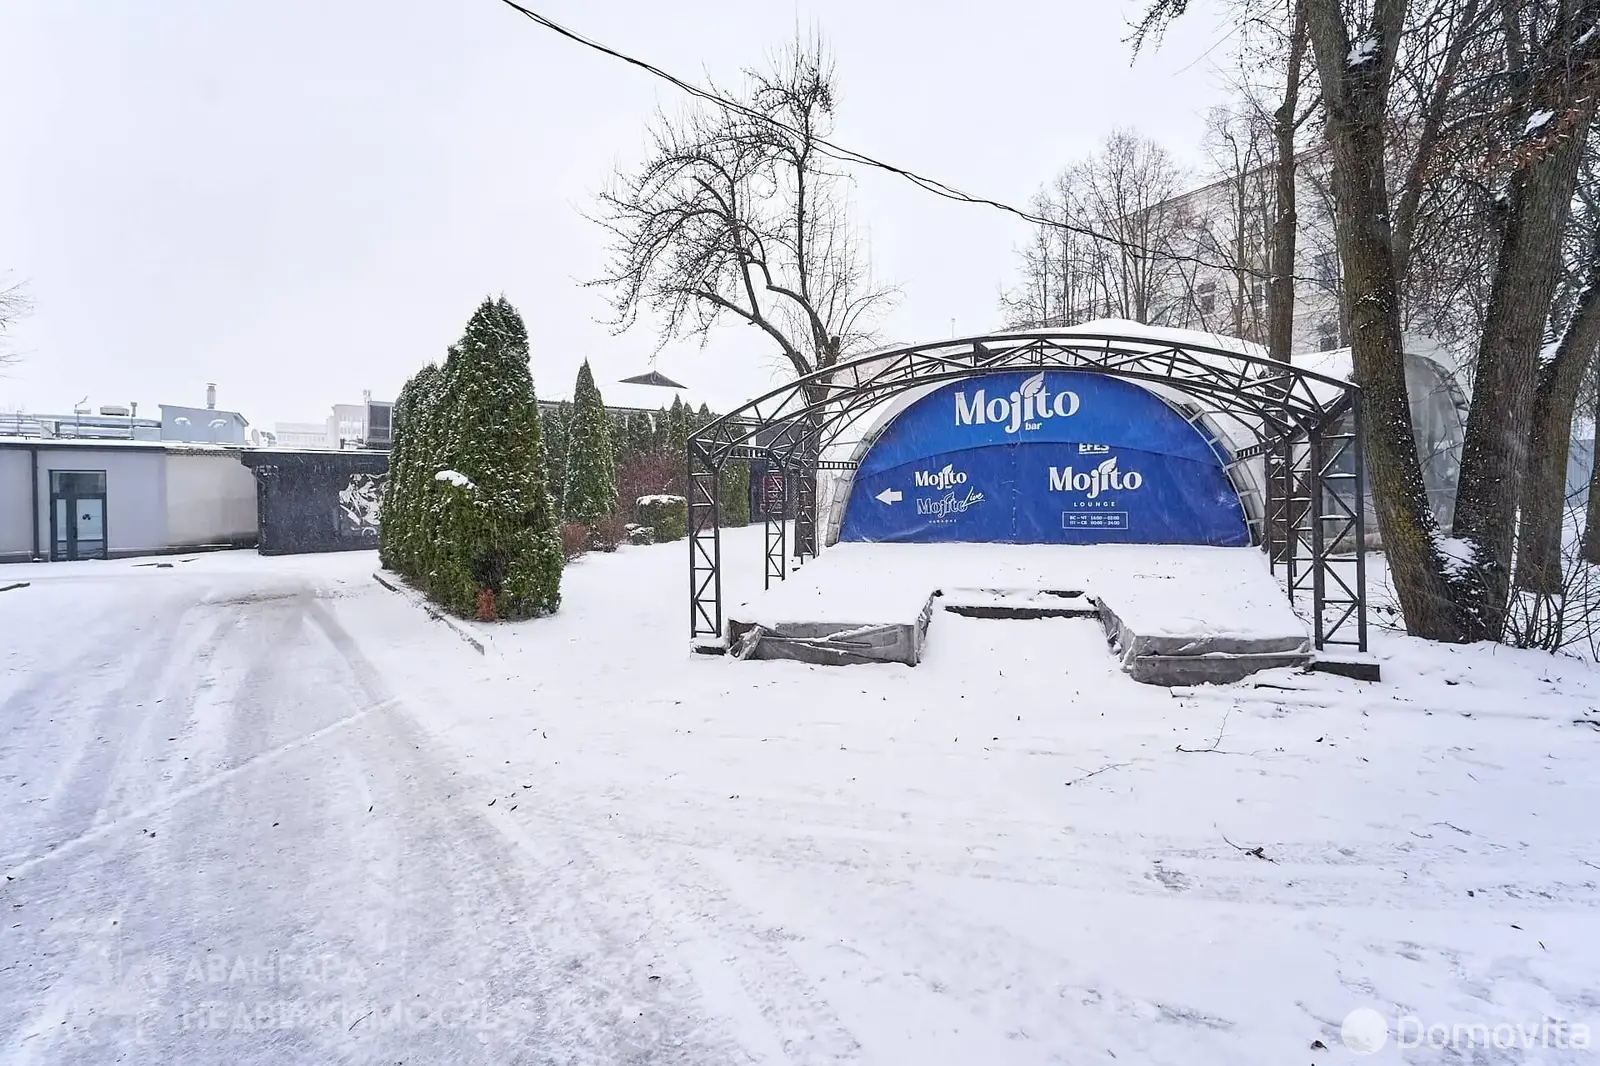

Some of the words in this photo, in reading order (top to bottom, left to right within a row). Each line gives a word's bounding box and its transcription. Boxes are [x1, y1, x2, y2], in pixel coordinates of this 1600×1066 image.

[955, 371, 1080, 434] Mojito
[1025, 422, 1042, 431] bar
[915, 463, 967, 490] Mojito
[1049, 456, 1143, 499] Mojito
[916, 491, 968, 518] Mojito
